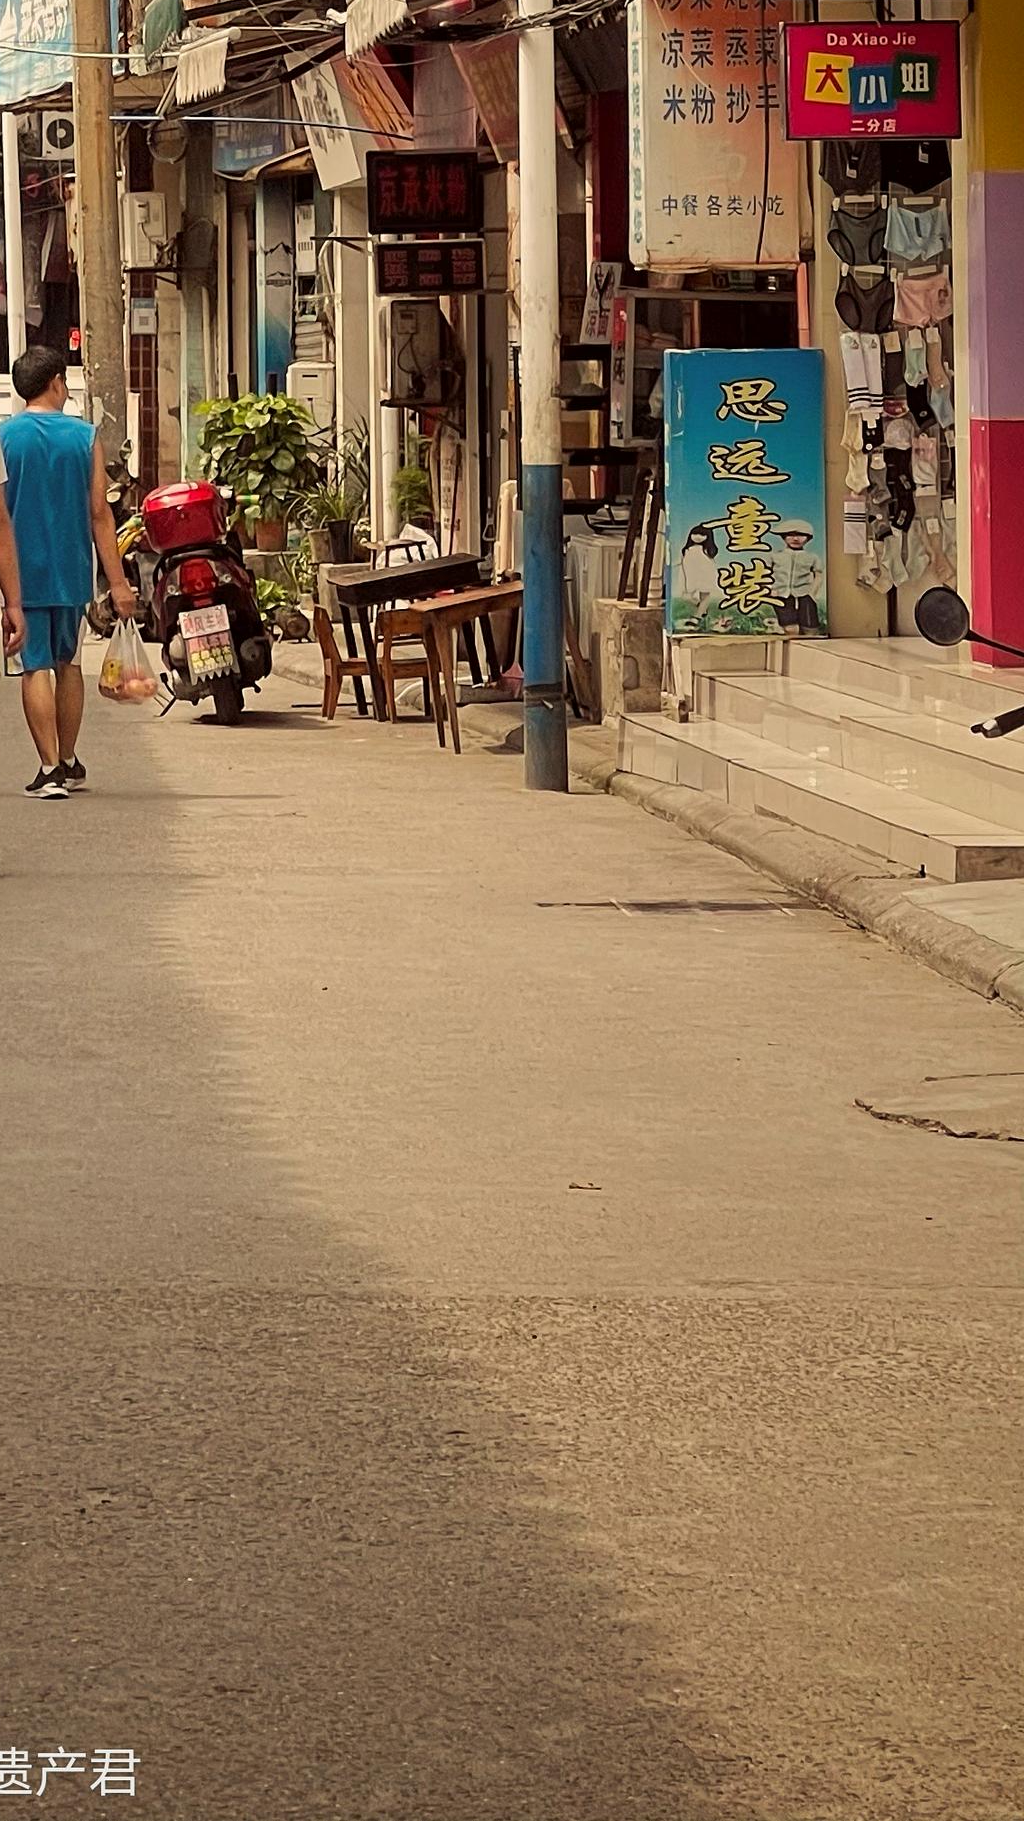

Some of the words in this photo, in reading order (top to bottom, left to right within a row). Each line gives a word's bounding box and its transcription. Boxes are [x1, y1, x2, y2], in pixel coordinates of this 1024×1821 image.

[661, 27, 714, 69] 凉菜
[725, 28, 779, 68] 蒸菜
[826, 32, 848, 46] Da
[852, 32, 889, 46] Xiao
[892, 32, 917, 46] Jie
[663, 83, 716, 125] 米粉
[726, 84, 780, 125] 抄手
[814, 62, 930, 105] 大小姐
[850, 118, 898, 133] 二分店
[662, 195, 699, 217] 中餐
[706, 194, 785, 217] 各类小吃
[707, 377, 792, 615] 思远童装
